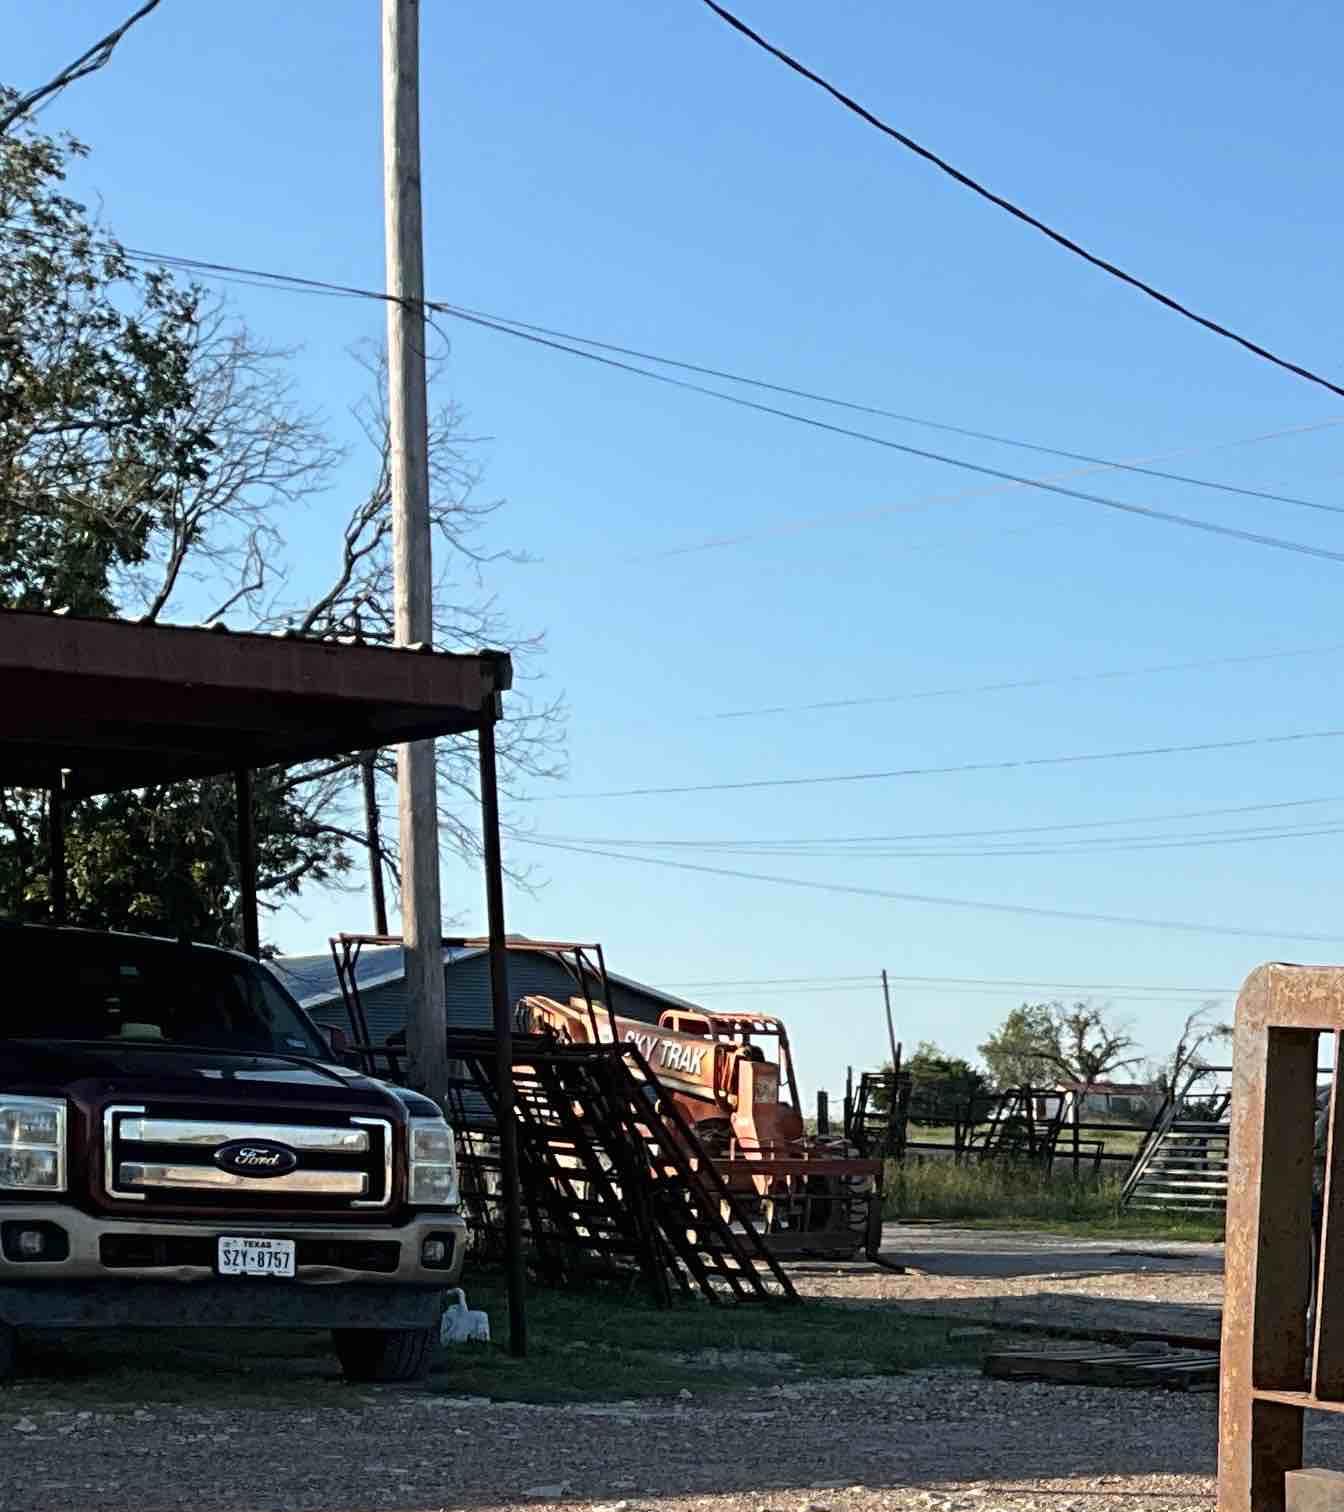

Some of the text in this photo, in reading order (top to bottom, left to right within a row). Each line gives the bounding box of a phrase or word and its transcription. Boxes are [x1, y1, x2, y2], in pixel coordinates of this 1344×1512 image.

[624, 1031, 706, 1074] SKY TRAK
[234, 1148, 281, 1167] Ford
[243, 1239, 272, 1249] TEXAS
